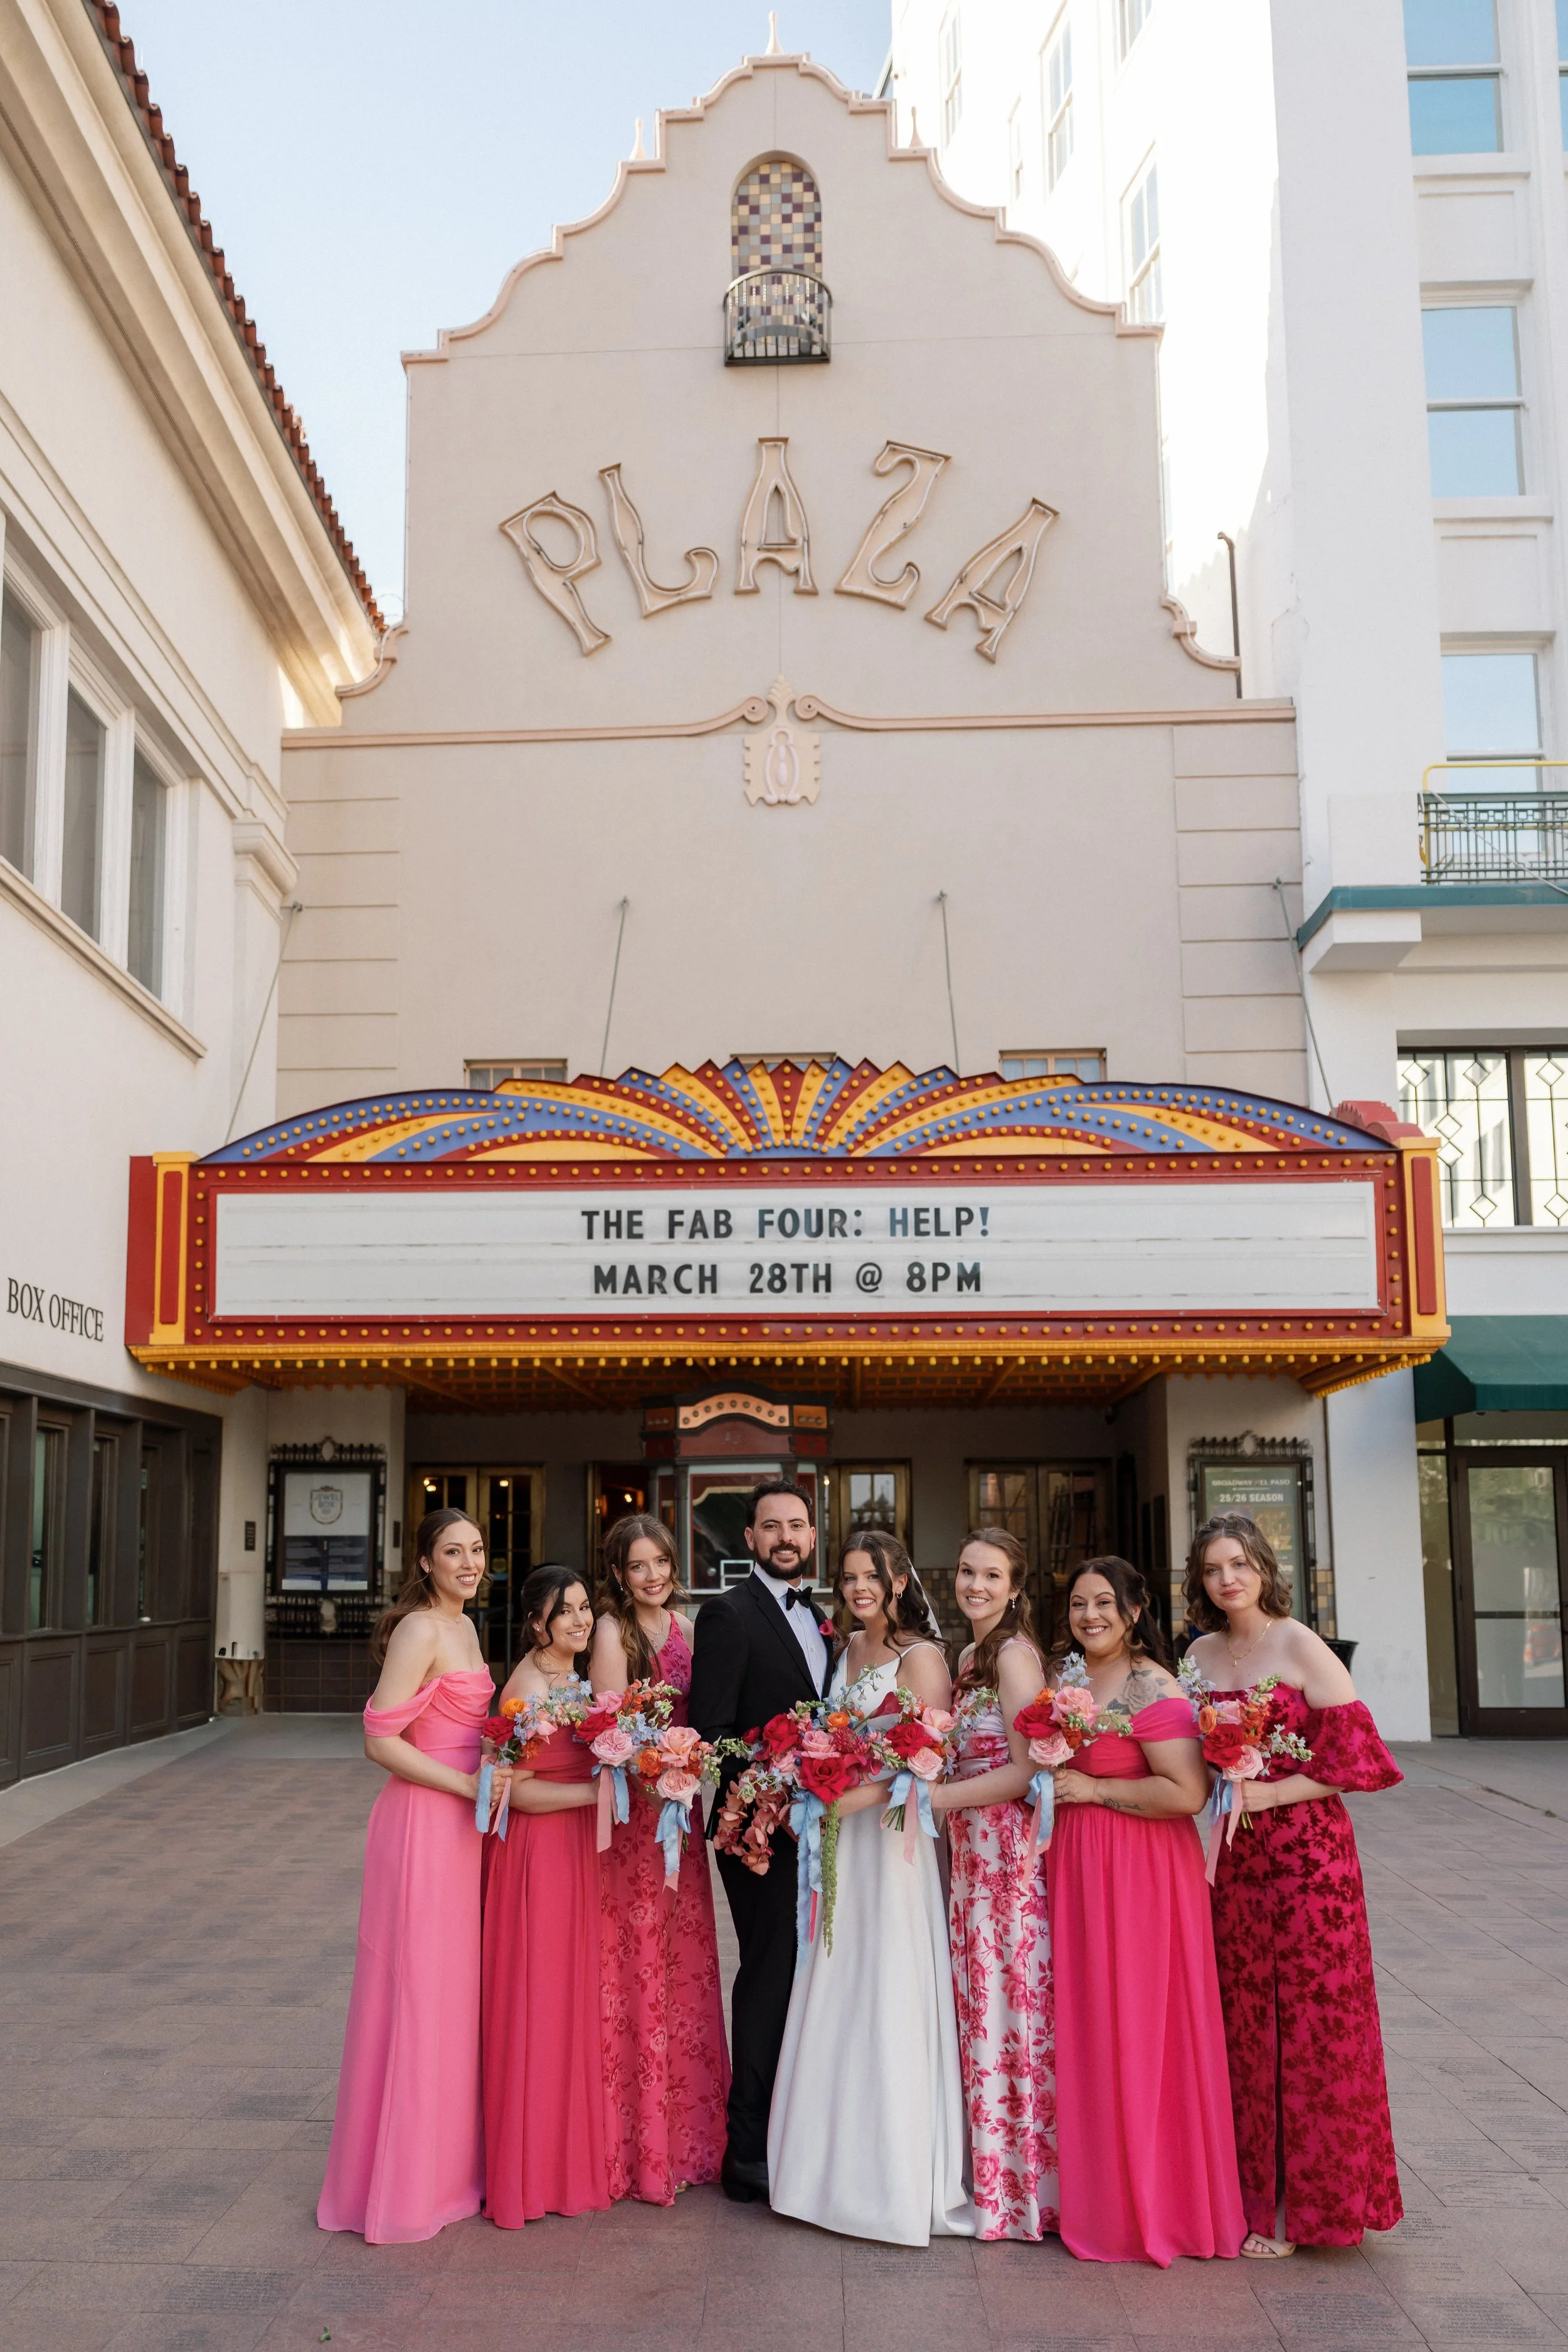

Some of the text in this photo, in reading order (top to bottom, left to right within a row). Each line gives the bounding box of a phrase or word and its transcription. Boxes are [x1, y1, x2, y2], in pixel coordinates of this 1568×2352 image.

[499, 436, 1060, 664] PLAZA
[581, 1207, 989, 1240] THE FAB FOUR: HELP!
[593, 1261, 981, 1295] MARCH 28TH @ 8PM
[6, 1277, 104, 1342] BOX OFFICE
[1219, 1493, 1284, 1503] 25/26 SEASON
